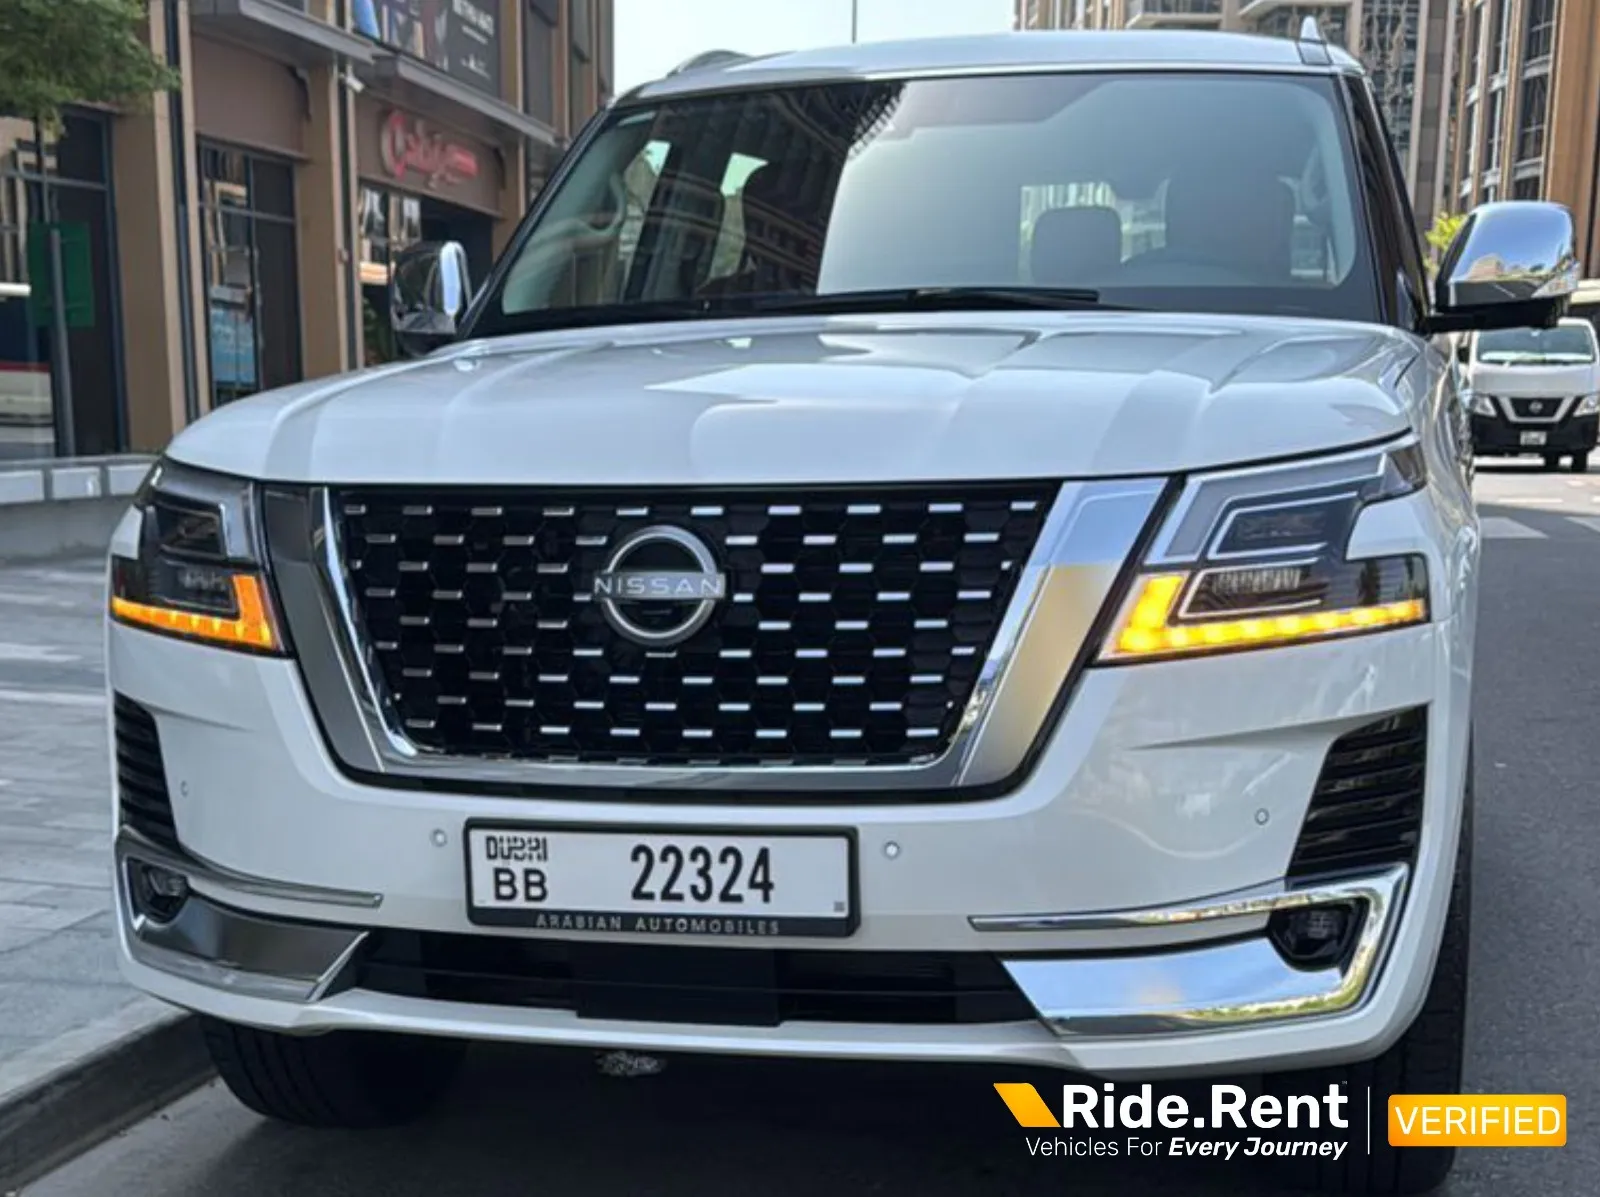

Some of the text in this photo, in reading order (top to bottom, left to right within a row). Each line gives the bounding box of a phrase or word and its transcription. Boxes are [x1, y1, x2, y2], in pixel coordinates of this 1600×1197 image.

[594, 577, 721, 595] NISSAN
[493, 867, 548, 903] BB
[630, 844, 775, 904] 22324
[535, 914, 780, 935] ARABIAN AUTOMOBILES
